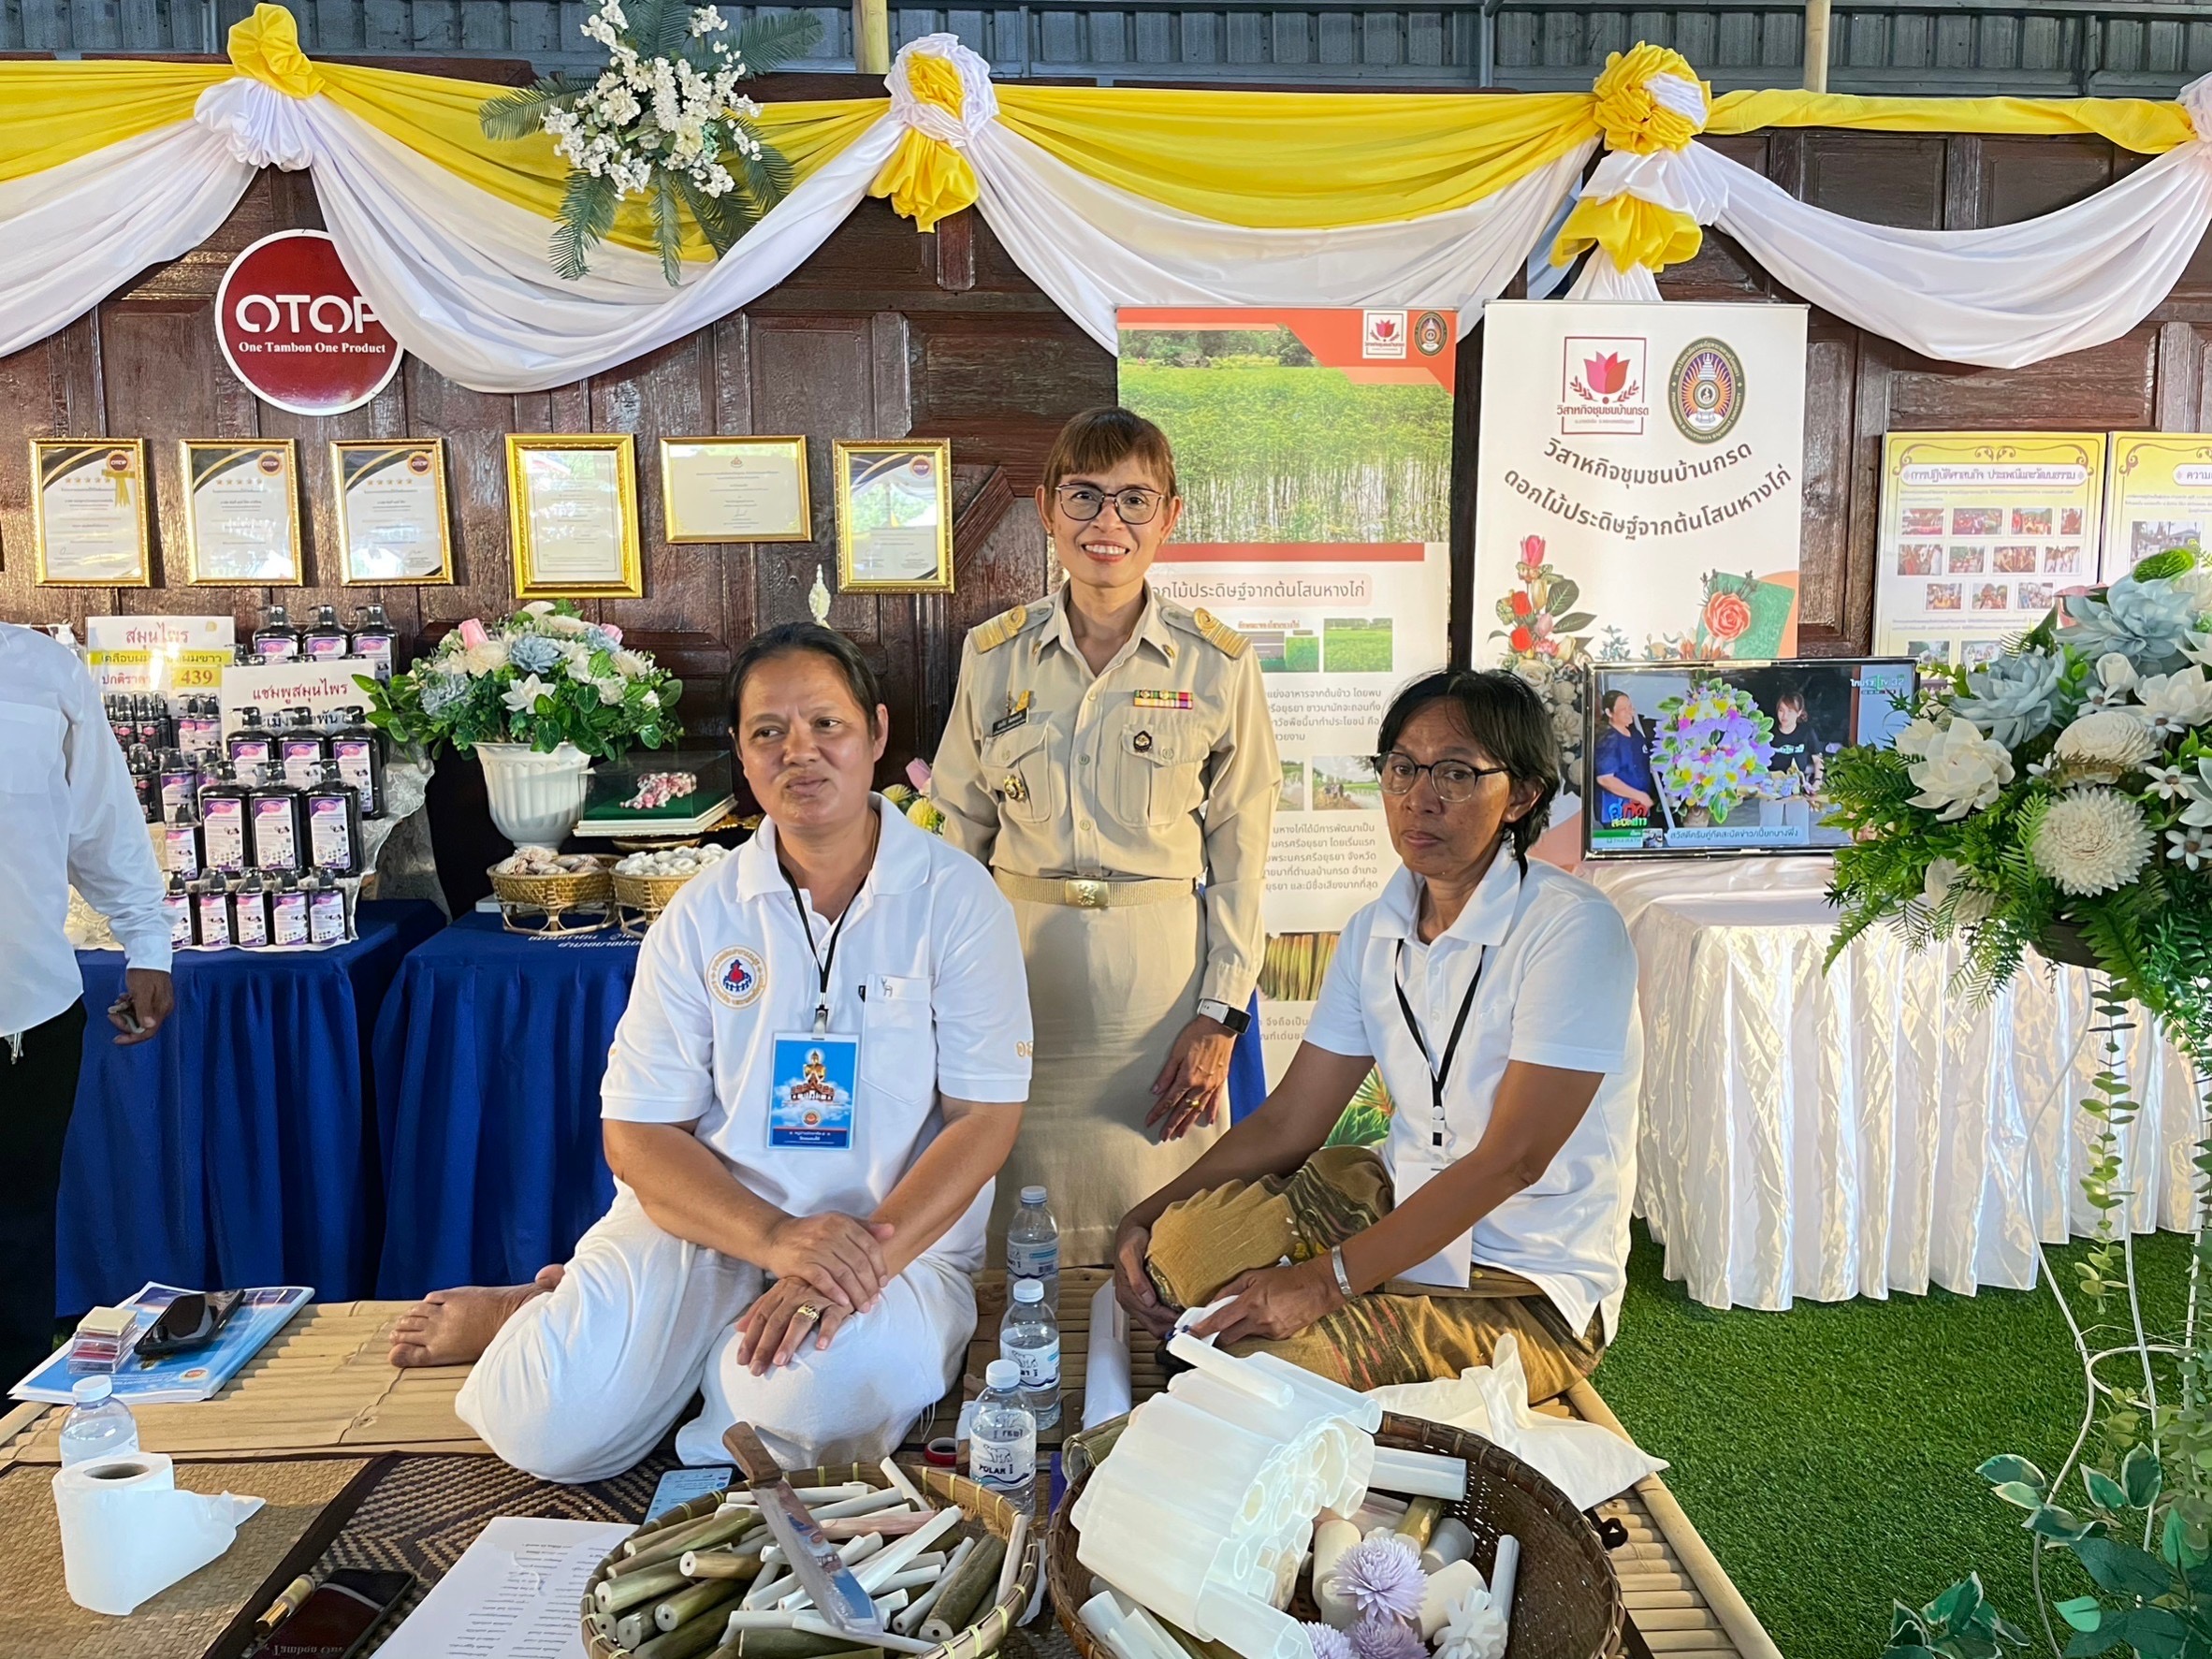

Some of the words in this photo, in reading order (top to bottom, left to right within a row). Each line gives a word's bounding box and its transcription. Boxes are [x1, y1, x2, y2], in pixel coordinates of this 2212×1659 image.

[236, 294, 378, 334] OTOP
[239, 342, 263, 353] One
[265, 342, 313, 353] Tambon
[314, 342, 339, 354] One
[342, 342, 386, 354] Product
[1544, 437, 1753, 489] วิสาหกิจชุมชนบ้านกรด
[1504, 464, 1792, 540] ดอกไม้ประดิษฐ์จากต้นโสนหางไก่
[1152, 580, 1364, 601] อกไม้ประดิษฐ์จากต้นโสนหางไก่
[181, 669, 213, 685] 439
[253, 677, 349, 704] แชมพูสมุนไพร
[1268, 704, 1303, 714] รีอยุธยา
[979, 1463, 1006, 1474] POLAR
